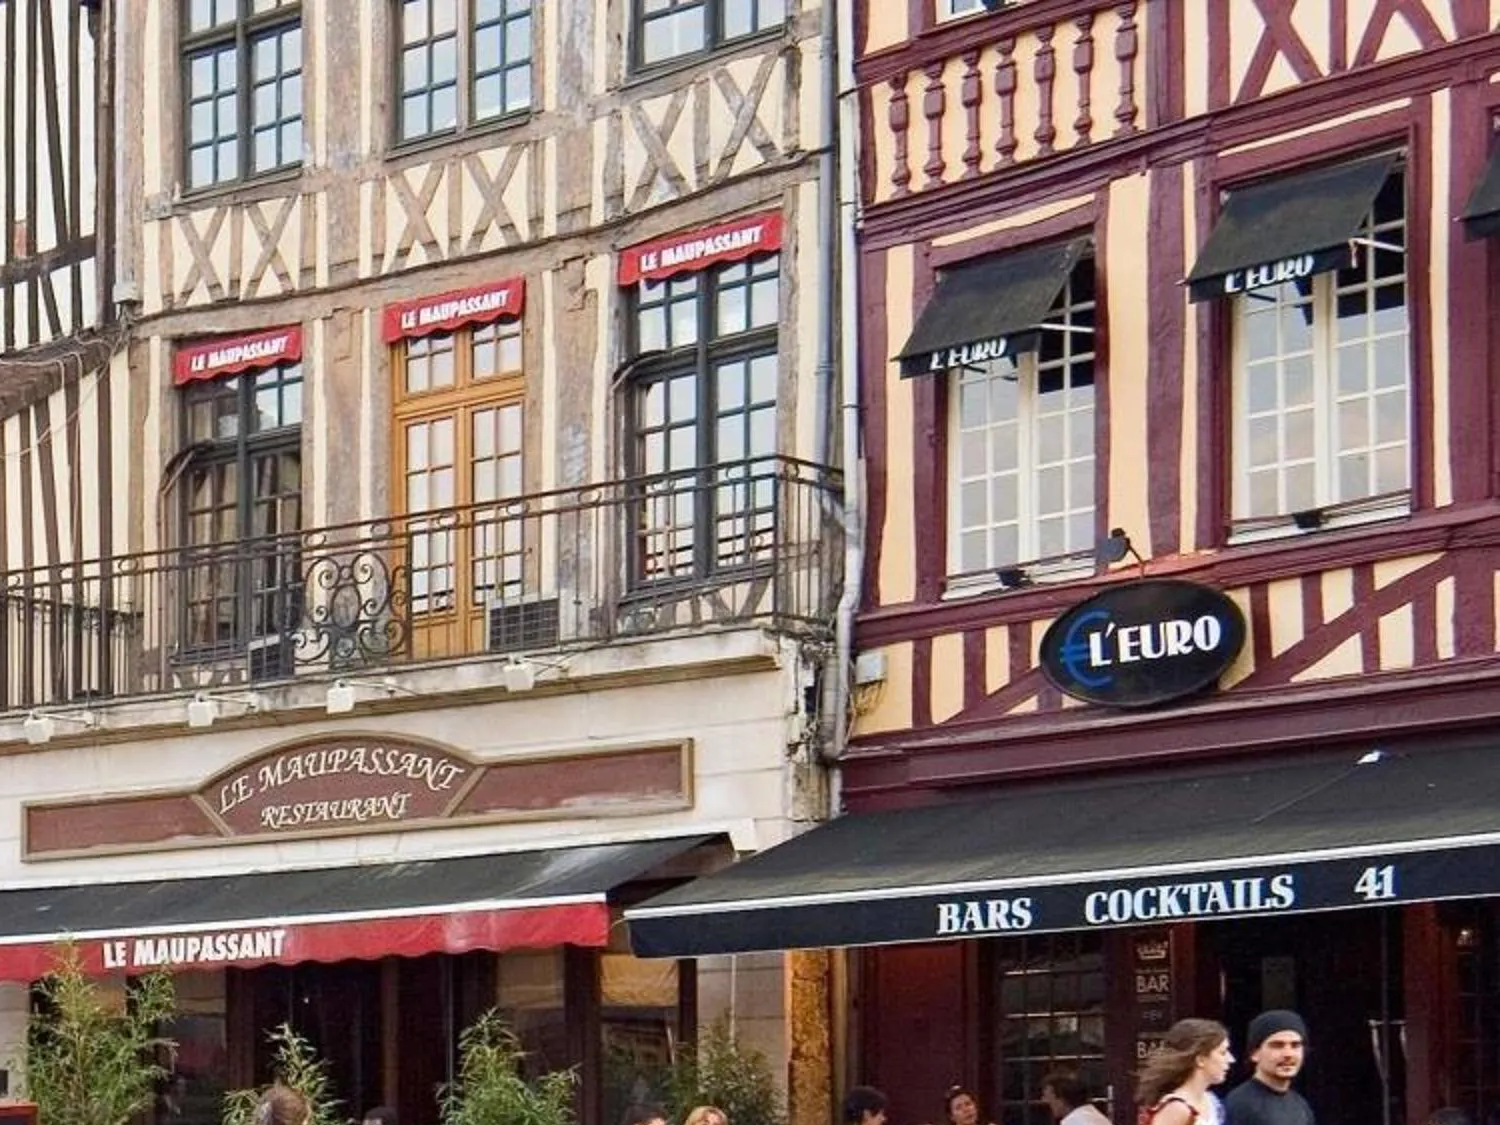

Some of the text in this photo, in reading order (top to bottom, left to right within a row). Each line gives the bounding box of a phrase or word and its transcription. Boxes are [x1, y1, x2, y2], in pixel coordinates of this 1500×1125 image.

[641, 225, 763, 272] LE MAUPASSANT
[402, 289, 509, 330] LE MAUPASSANT
[191, 336, 288, 371] LE MAUPASSANT
[1089, 615, 1221, 667] L'EURO
[219, 747, 464, 815] LE MAUPASSANT
[261, 792, 411, 828] RESTAURANT
[937, 865, 1396, 935] BARS COCKTAILS 41
[103, 929, 285, 968] LE MAUPASSANT
[1136, 974, 1169, 992] BAR
